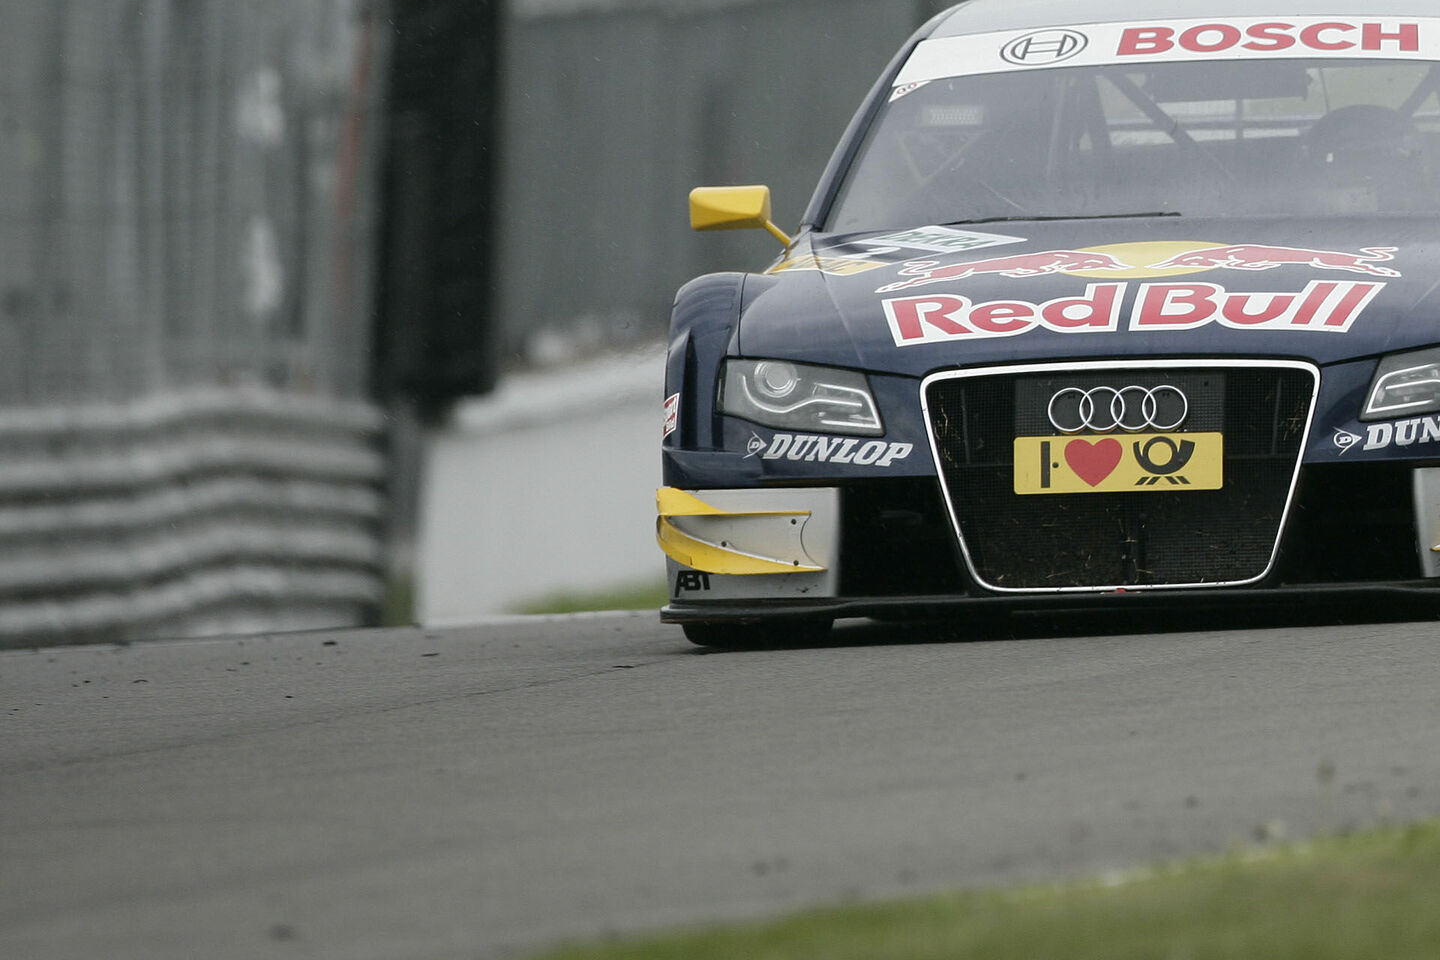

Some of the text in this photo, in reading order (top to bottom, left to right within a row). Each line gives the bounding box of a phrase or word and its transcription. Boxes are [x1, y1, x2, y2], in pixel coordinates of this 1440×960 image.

[1116, 22, 1420, 57] BOSCH
[888, 280, 1380, 342] Red Bull
[762, 433, 914, 467] DUNLOP
[674, 569, 714, 598] ABT
